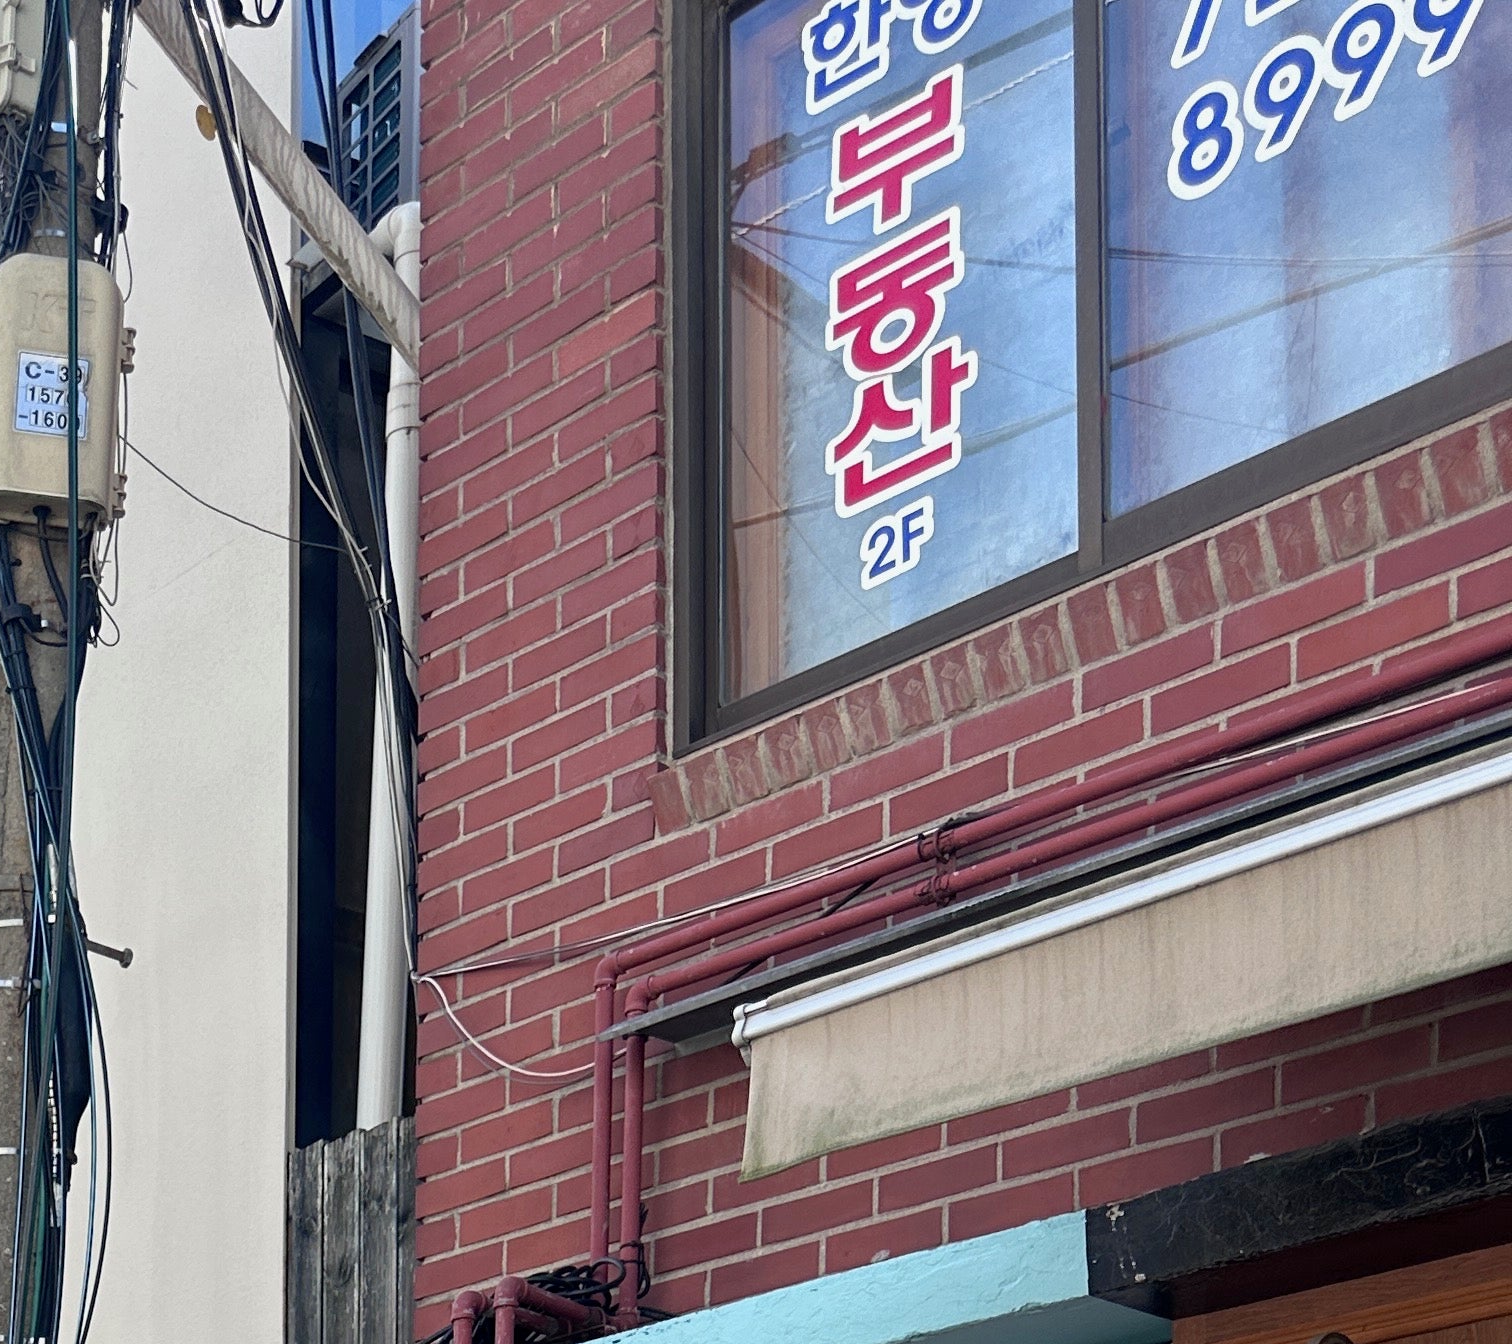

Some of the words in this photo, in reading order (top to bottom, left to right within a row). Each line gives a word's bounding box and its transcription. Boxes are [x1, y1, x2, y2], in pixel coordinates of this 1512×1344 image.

[1177, 0, 1476, 186] 8999
[831, 74, 970, 509] 부동산
[27, 386, 78, 405] 157
[868, 516, 925, 579] 2F
